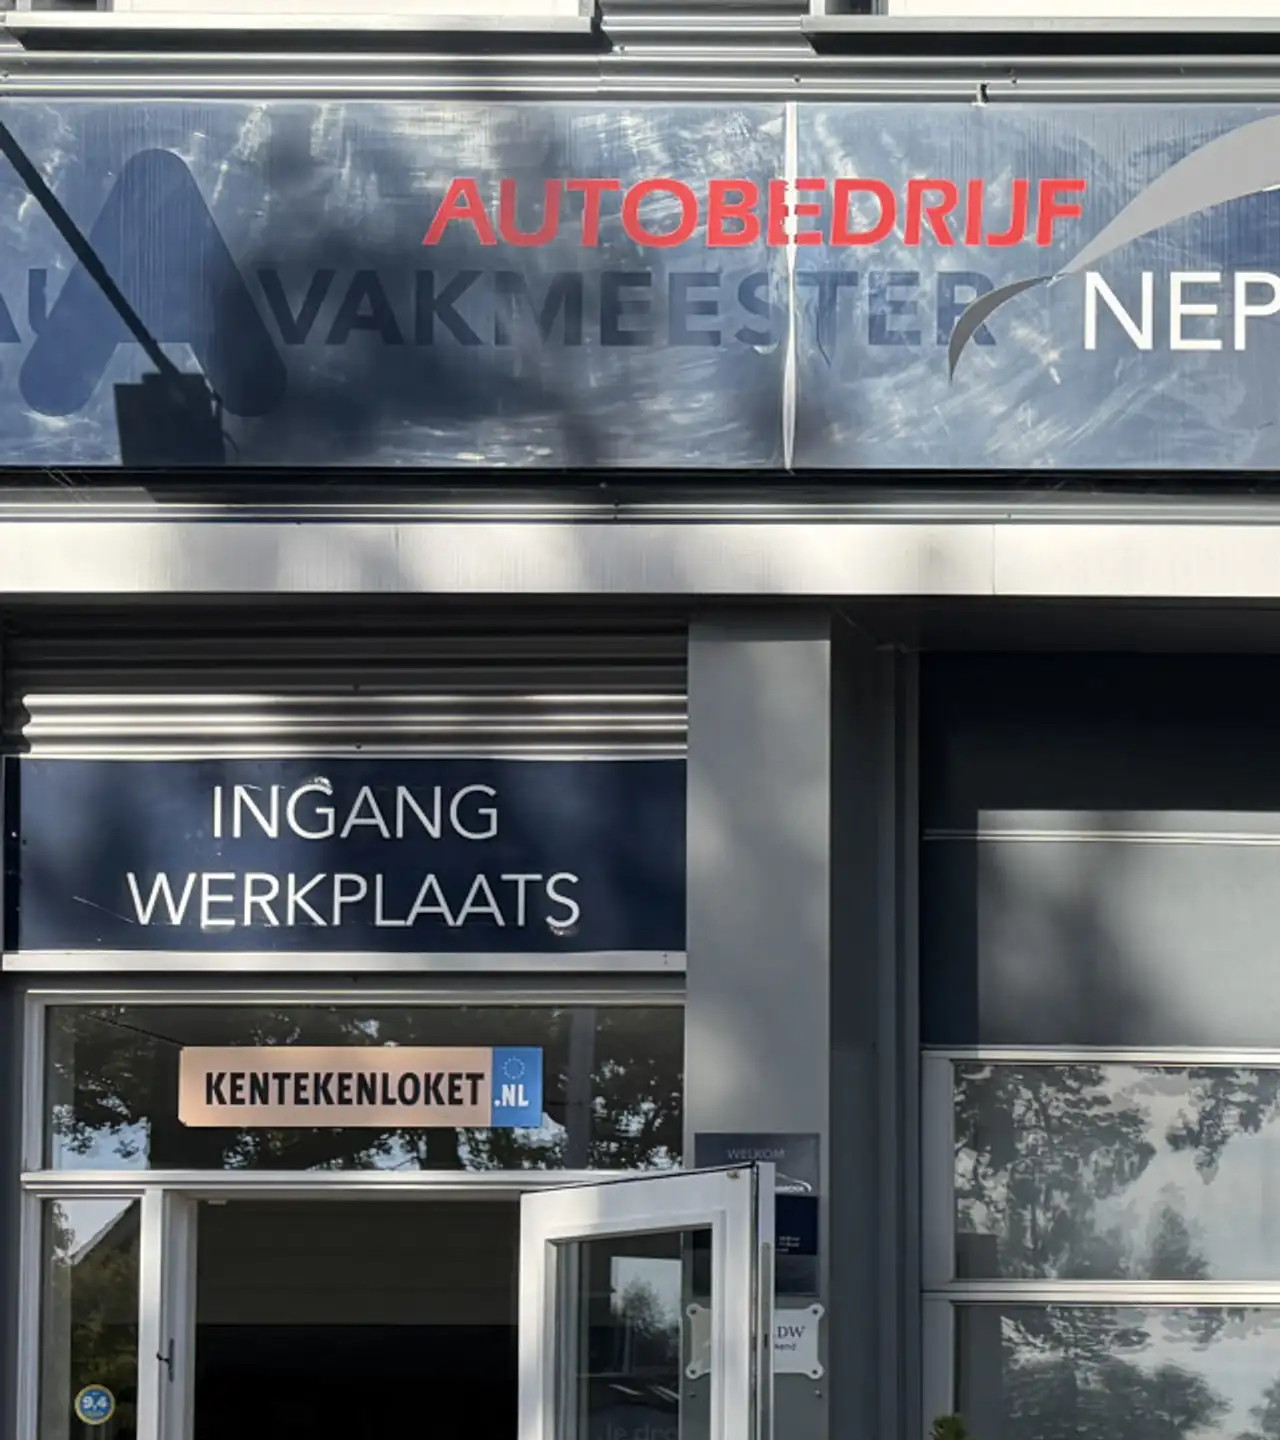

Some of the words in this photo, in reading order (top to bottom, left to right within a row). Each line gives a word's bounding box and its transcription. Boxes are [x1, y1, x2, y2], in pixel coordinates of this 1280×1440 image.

[423, 178, 1087, 248] AUTOBEDRIJF
[213, 783, 498, 840] INGANG
[126, 871, 581, 929] WERKPLAATS
[204, 1071, 485, 1107] KENTEKENLOKET
[493, 1083, 530, 1108] .NL
